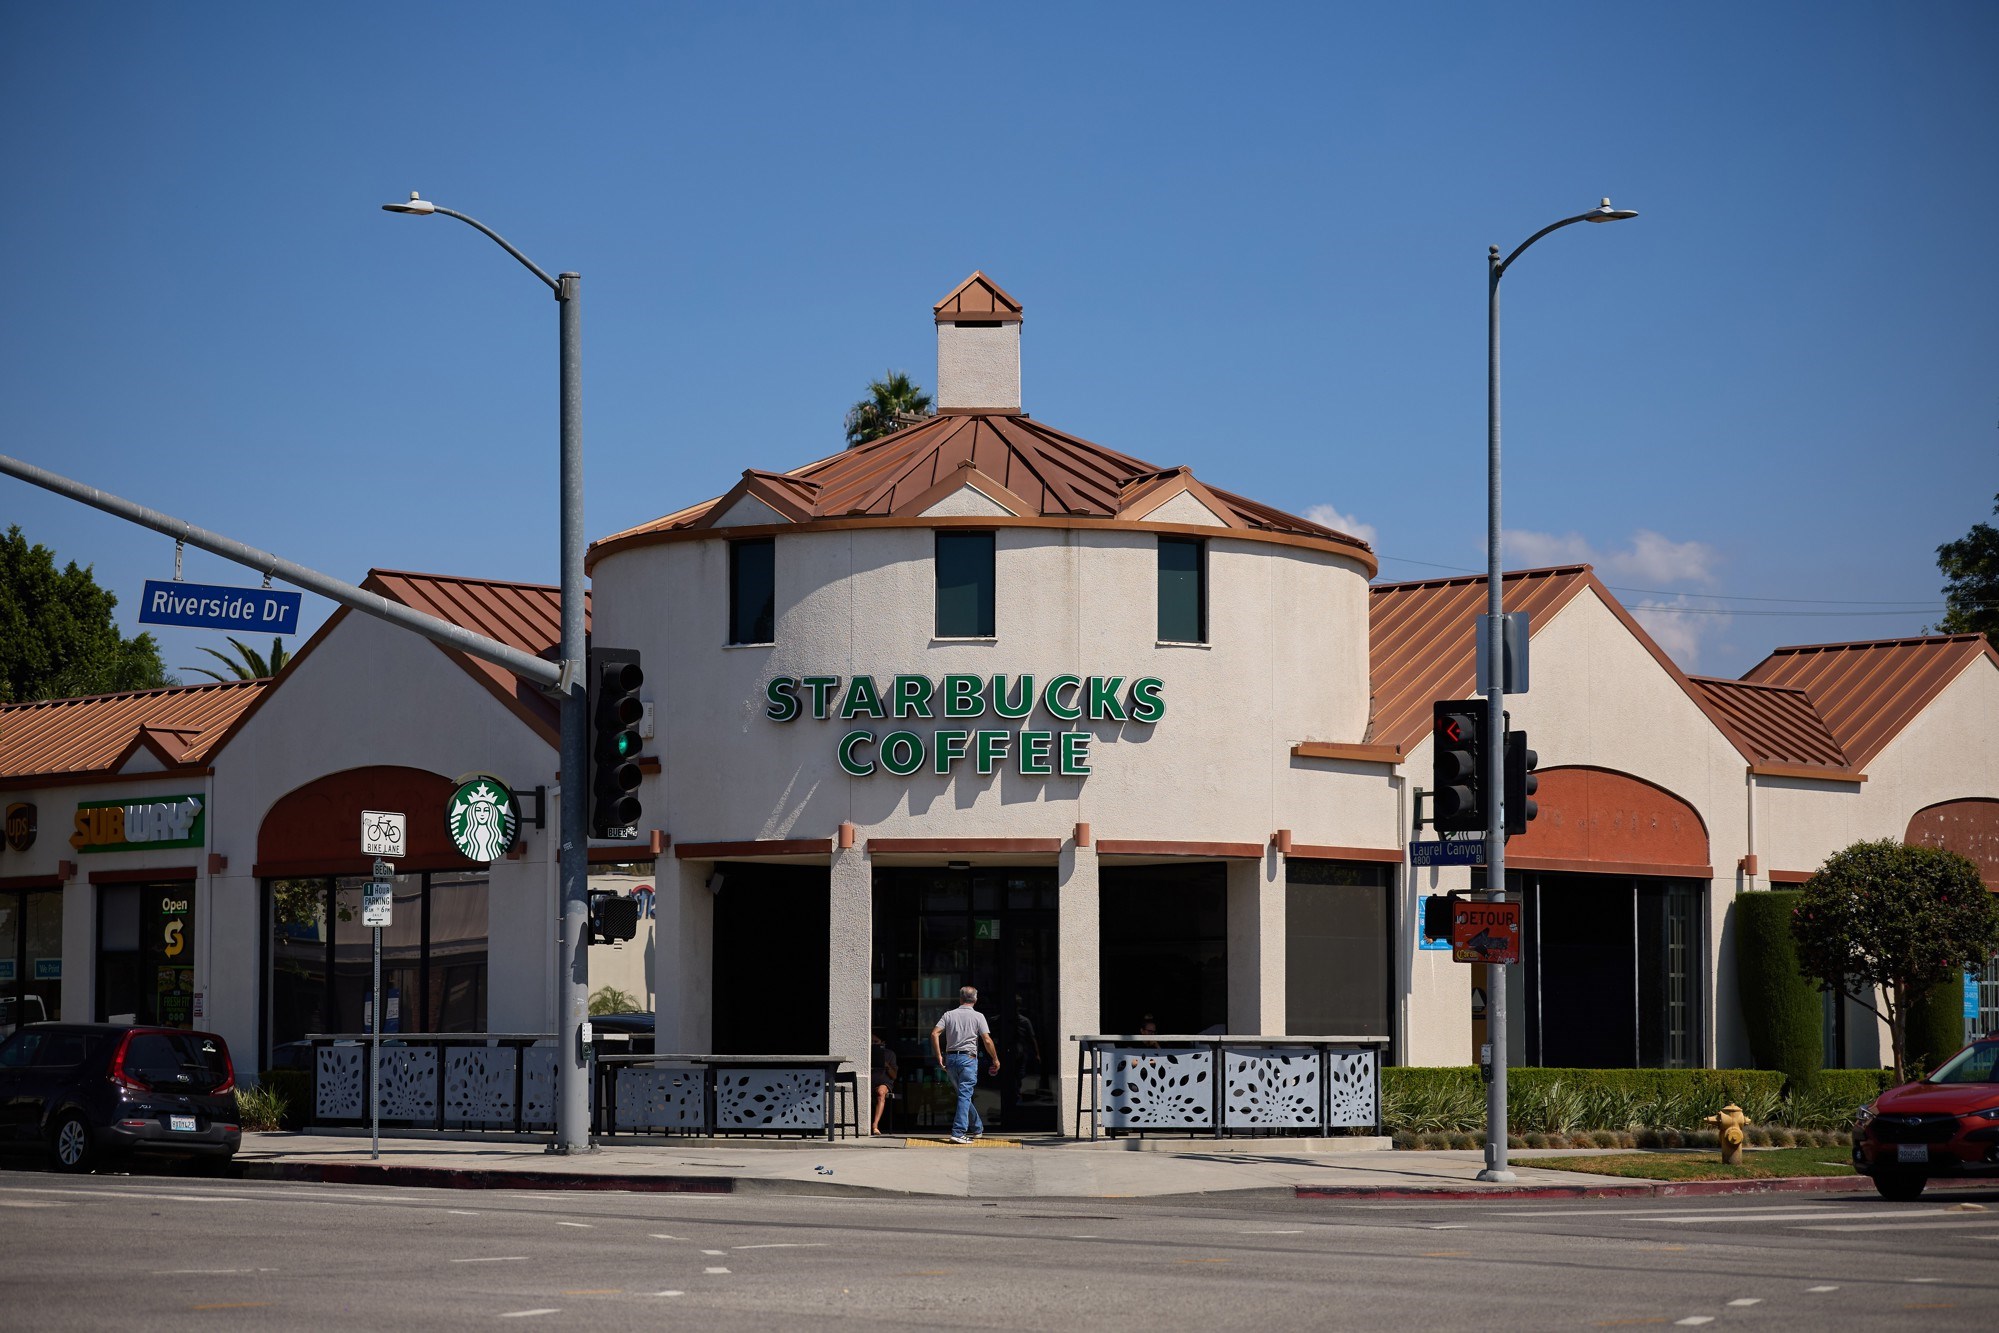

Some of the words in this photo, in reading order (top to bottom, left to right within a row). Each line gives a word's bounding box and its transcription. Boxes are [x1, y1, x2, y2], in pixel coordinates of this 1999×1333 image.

[151, 590, 255, 620] Riverside
[262, 599, 289, 622] Dr
[764, 673, 1167, 723] STARBUCKS
[836, 729, 1093, 776] COFFEE
[8, 817, 27, 844] ups
[69, 797, 203, 850] SUBWAY
[367, 843, 382, 852] BIKE
[383, 845, 400, 854] LANE
[1412, 843, 1442, 856] Laurel
[1446, 842, 1482, 858] Canyon
[1412, 855, 1431, 865] 4800
[375, 865, 393, 876] BEGIN
[374, 886, 390, 895] HOUR
[162, 897, 188, 914] Open
[364, 896, 390, 906] PARKING
[1460, 911, 1514, 925] DETOUR
[978, 923, 989, 935] A
[163, 996, 181, 1007] FRESH
[181, 996, 190, 1007] FIT
